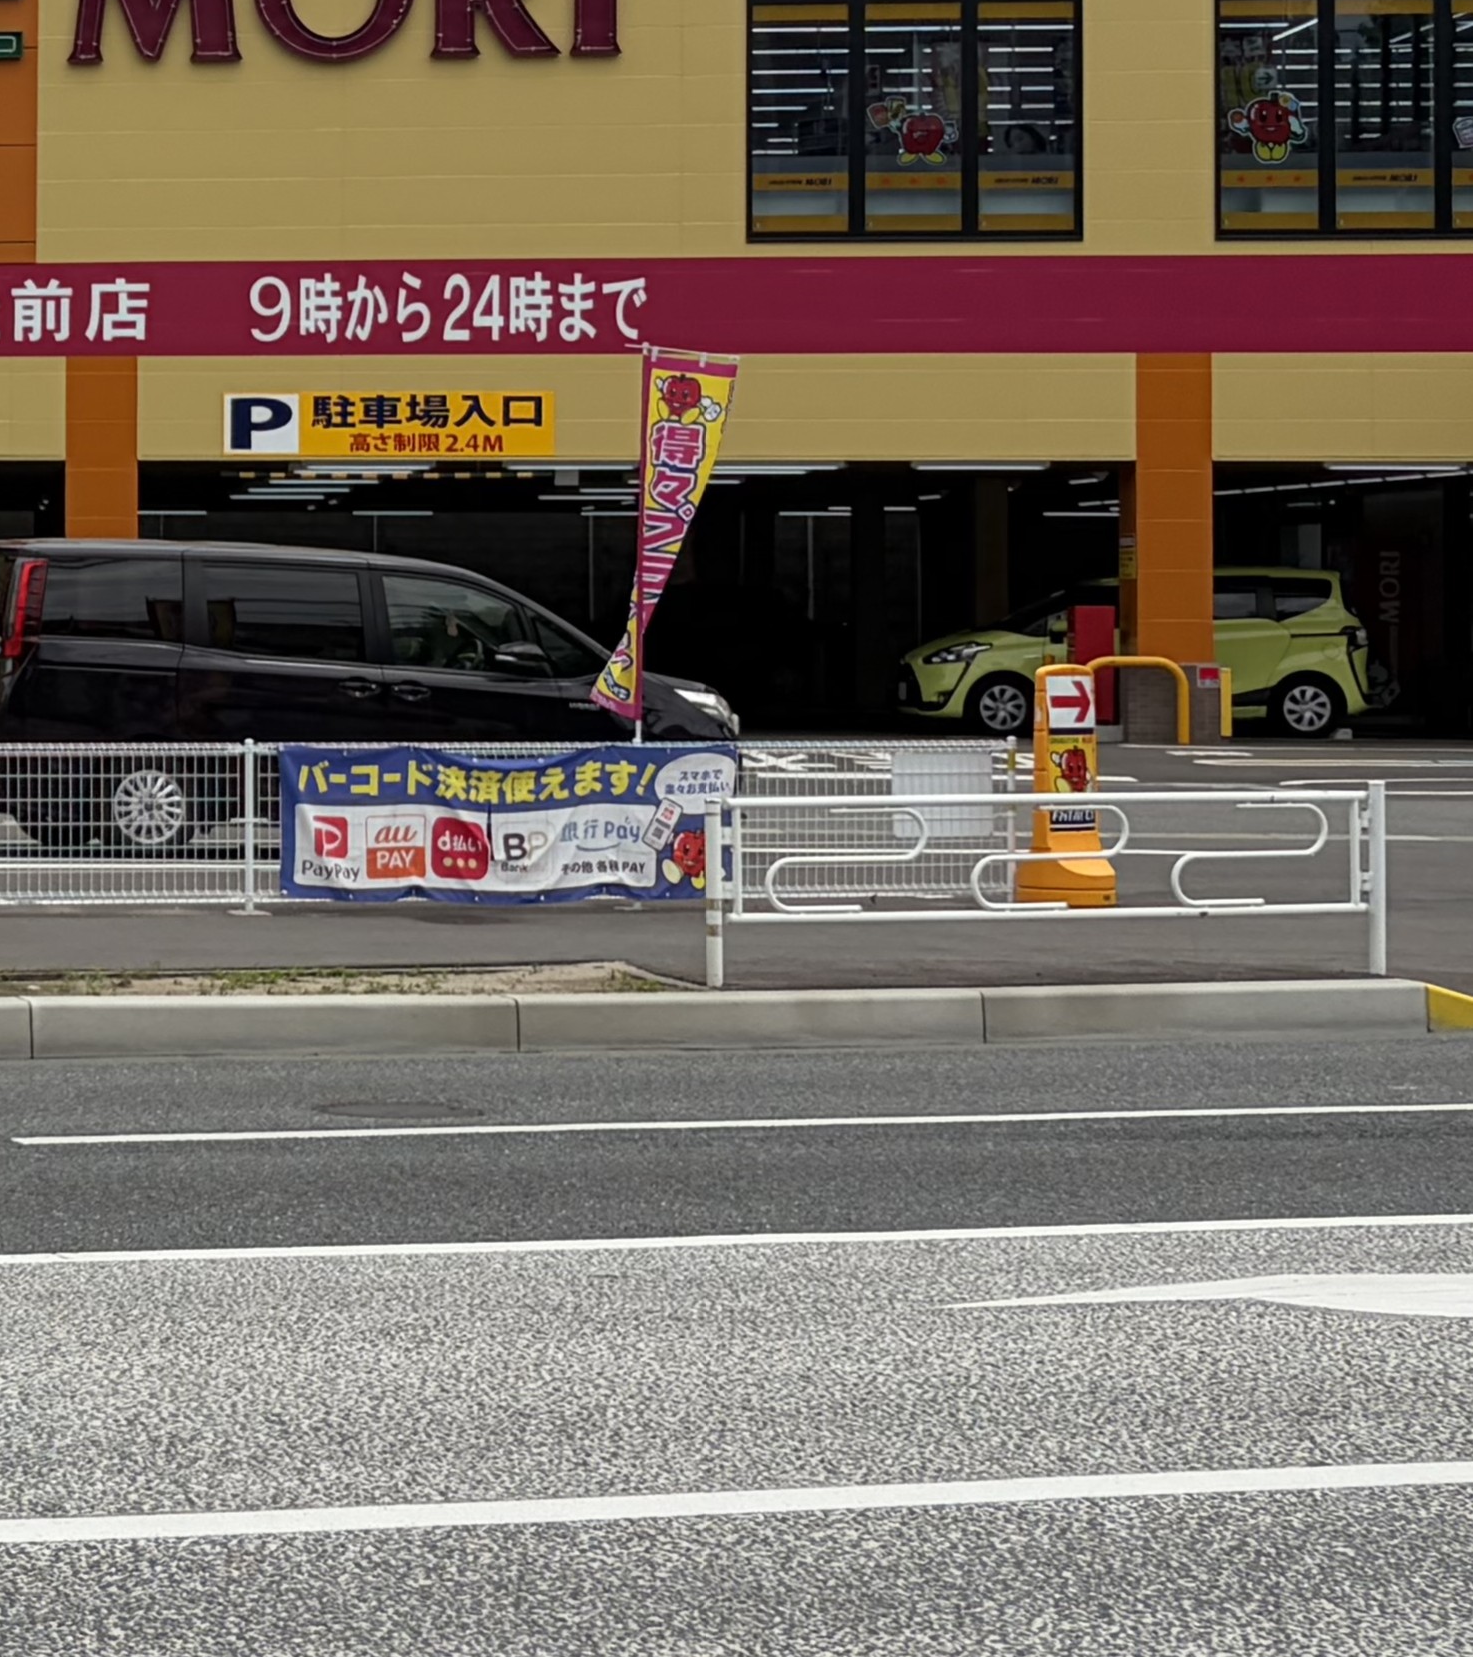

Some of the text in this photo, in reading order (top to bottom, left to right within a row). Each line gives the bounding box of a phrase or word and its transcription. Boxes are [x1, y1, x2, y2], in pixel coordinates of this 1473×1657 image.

[312, 395, 543, 428] 駐車場入口
[230, 398, 293, 450] P
[374, 824, 418, 845] au
[302, 859, 360, 881] PayPay
[376, 849, 415, 870] PAY
